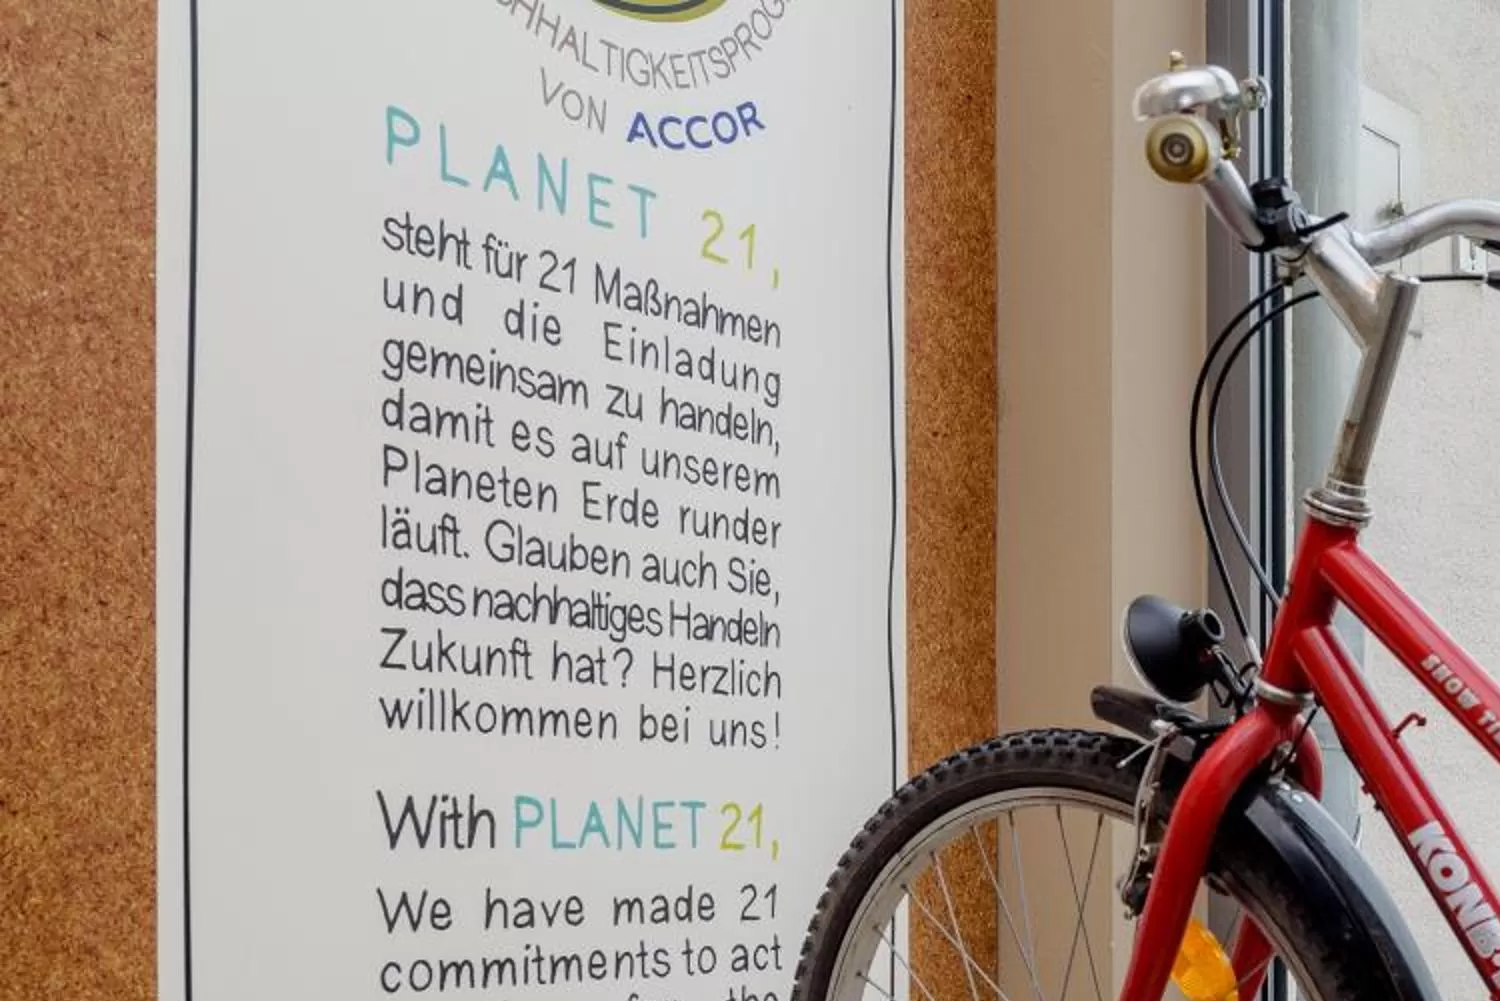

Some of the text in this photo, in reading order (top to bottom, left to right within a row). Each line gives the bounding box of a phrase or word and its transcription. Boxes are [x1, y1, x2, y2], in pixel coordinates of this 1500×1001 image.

[540, 66, 765, 150] VON ACCOR
[385, 105, 780, 289] PLANET 21,
[382, 211, 781, 348] steht für 21 Maßnahmen
[383, 277, 781, 407] und die Einladung
[382, 337, 780, 455] gemeinsam zu handeln,
[382, 389, 781, 498] damit es auf unserem
[383, 444, 781, 548] Planeten Erde runder
[381, 505, 780, 607] läuft. Glauben auch Sie,
[381, 567, 781, 648] dass nachhaltiges Handeln
[379, 627, 781, 698] Zukunft hat? Herzlich
[378, 687, 780, 749] willkommen bei uns!
[376, 789, 780, 860] With PLANET 21,
[376, 884, 778, 933] We have made 21
[380, 933, 783, 992] commitments to act
